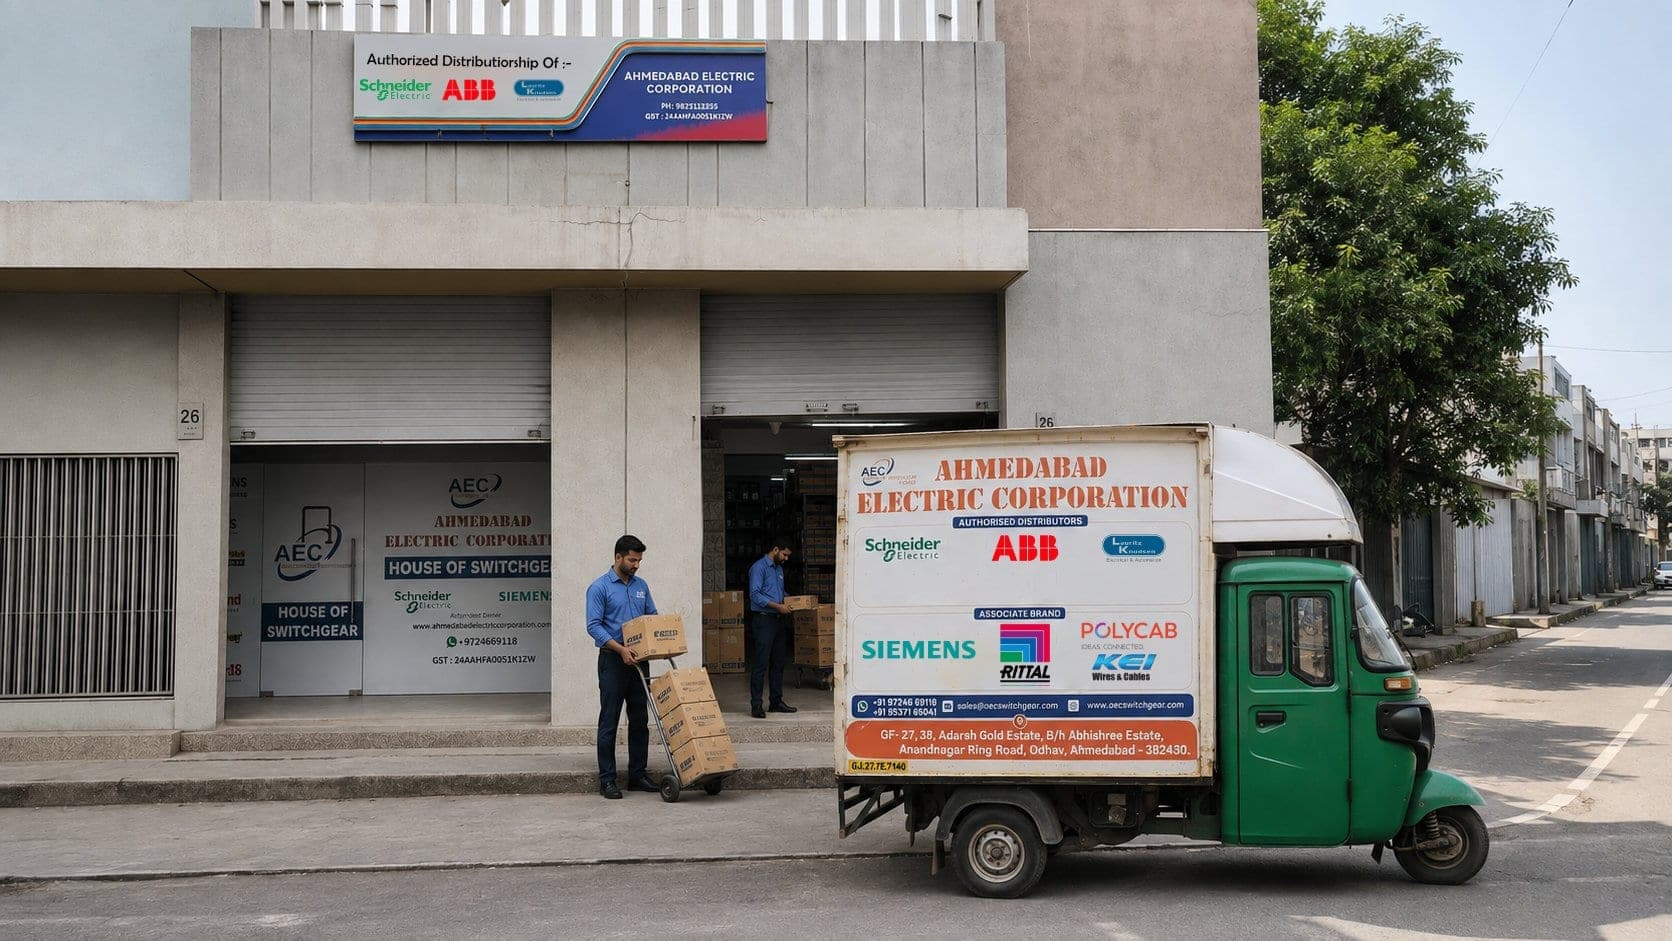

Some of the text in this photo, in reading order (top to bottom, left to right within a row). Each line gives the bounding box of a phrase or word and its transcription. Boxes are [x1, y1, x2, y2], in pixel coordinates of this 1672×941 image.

[366, 53, 439, 66] Authorized
[542, 56, 559, 69] Of
[624, 72, 756, 81] AHMEDABAD ELECTRIC
[359, 79, 432, 91] Schneider
[442, 79, 496, 101] ABB
[646, 84, 733, 94] CORPORATION
[390, 91, 430, 100] Electric
[181, 409, 200, 424] 26
[1039, 417, 1054, 428] 26
[861, 466, 885, 477] AEC
[934, 456, 1107, 481] AHMEDABAD
[448, 478, 489, 493] AEC
[857, 486, 1189, 513] ELECTRIC CORPORATION
[434, 514, 532, 528] AHMEDABAD
[958, 517, 1083, 527] AUTHORISED DISTRIBUTORS
[384, 534, 551, 548] ELECTRIC CORPORATI
[865, 537, 941, 552] Schneider
[991, 535, 1059, 561] ABB
[274, 544, 322, 562] AEC
[897, 551, 939, 560] Electric
[389, 559, 550, 575] HOUSE OF SWITCHGE
[394, 590, 451, 601] Schneider
[498, 591, 551, 602] SIEMEN
[278, 605, 349, 618] HOUSE OF
[979, 610, 1061, 618] ASSOCIATE BRAND
[267, 624, 358, 638] SWITCHGEAR
[1081, 622, 1178, 639] POLYCAB
[862, 640, 976, 659] SIEMENS
[432, 657, 448, 665] GST
[1092, 653, 1157, 671] KEI
[1000, 665, 1051, 679] RITTAL
[1092, 672, 1151, 681] Wires & Cables
[938, 730, 977, 740] Adarsh
[979, 730, 1004, 740] Gold
[1006, 730, 1044, 742] Estate,
[1046, 730, 1066, 741] B/h
[1068, 730, 1123, 741] Abhishree
[1125, 730, 1164, 742] Estate,
[899, 744, 965, 757] Anandnagar
[967, 744, 992, 757] Ring
[995, 744, 1026, 757] Road,
[1029, 744, 1067, 757] Odhav,
[1070, 744, 1136, 756] Ahmedabad
